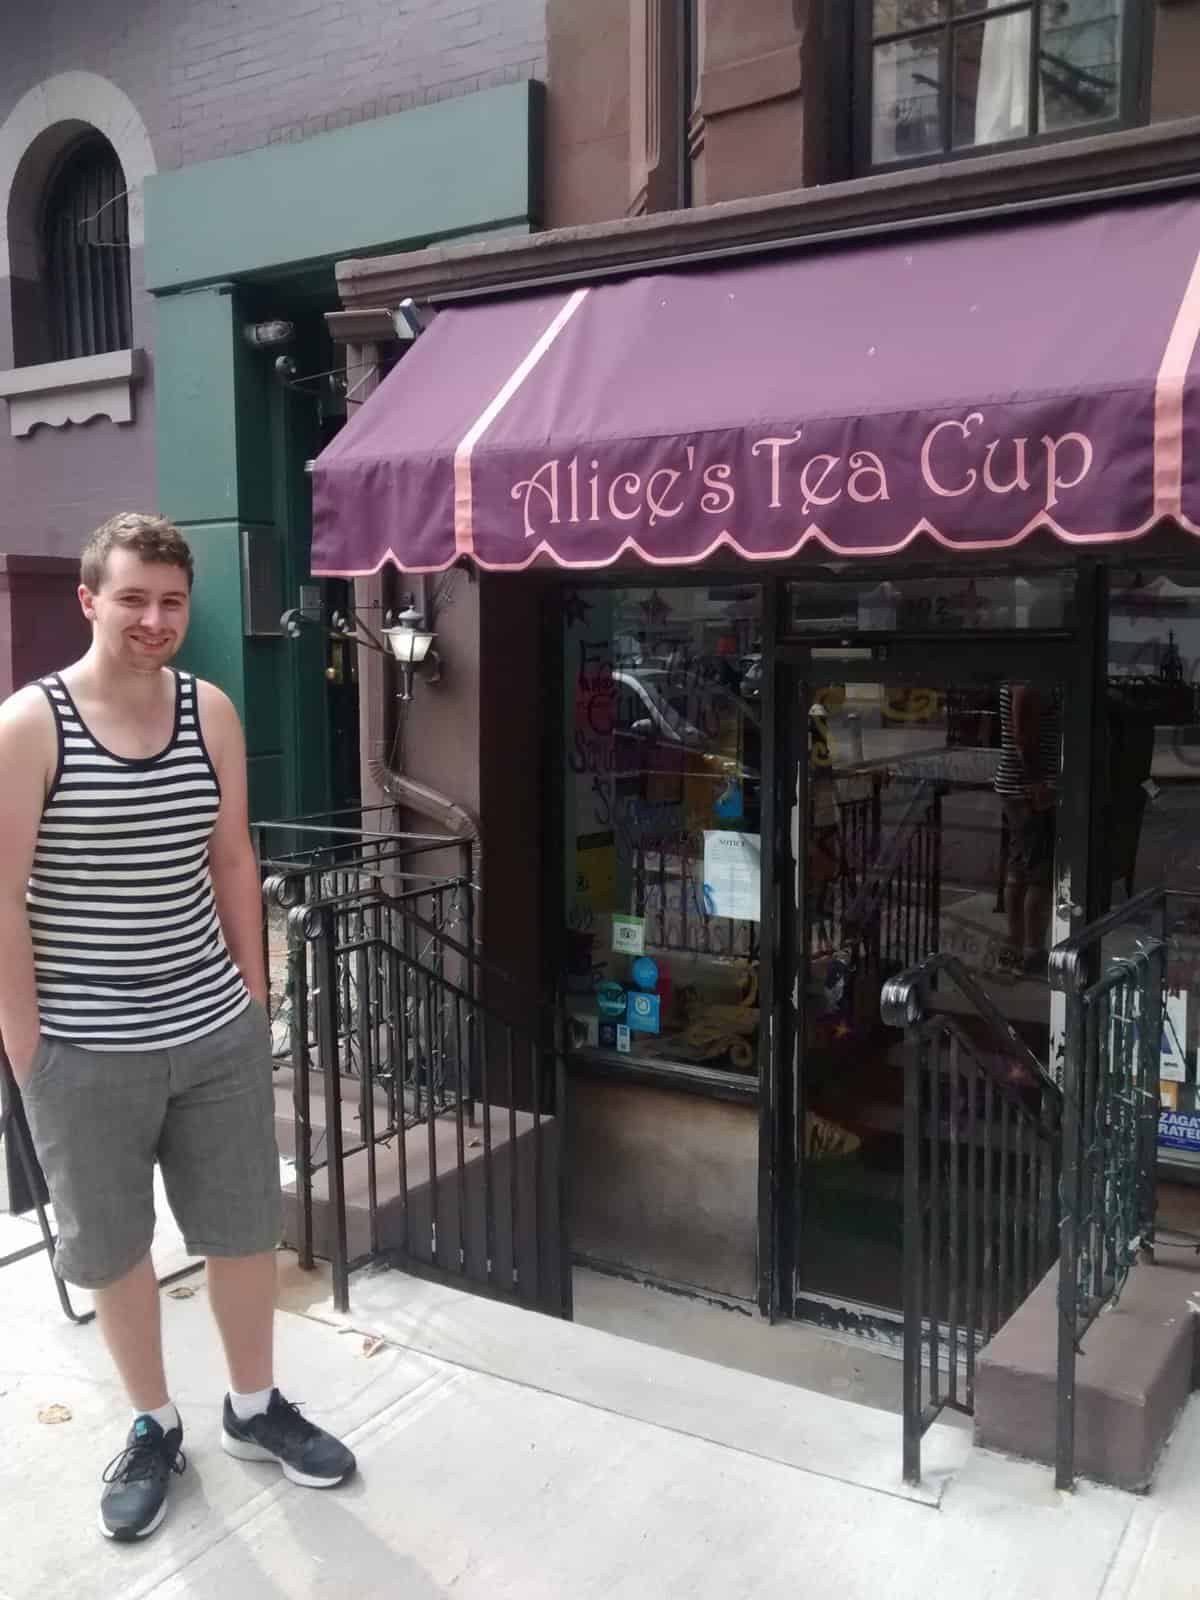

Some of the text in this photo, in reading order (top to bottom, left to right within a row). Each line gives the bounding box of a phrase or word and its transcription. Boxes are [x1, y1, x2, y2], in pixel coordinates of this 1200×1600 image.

[510, 411, 1094, 538] Alice's Tea Cup
